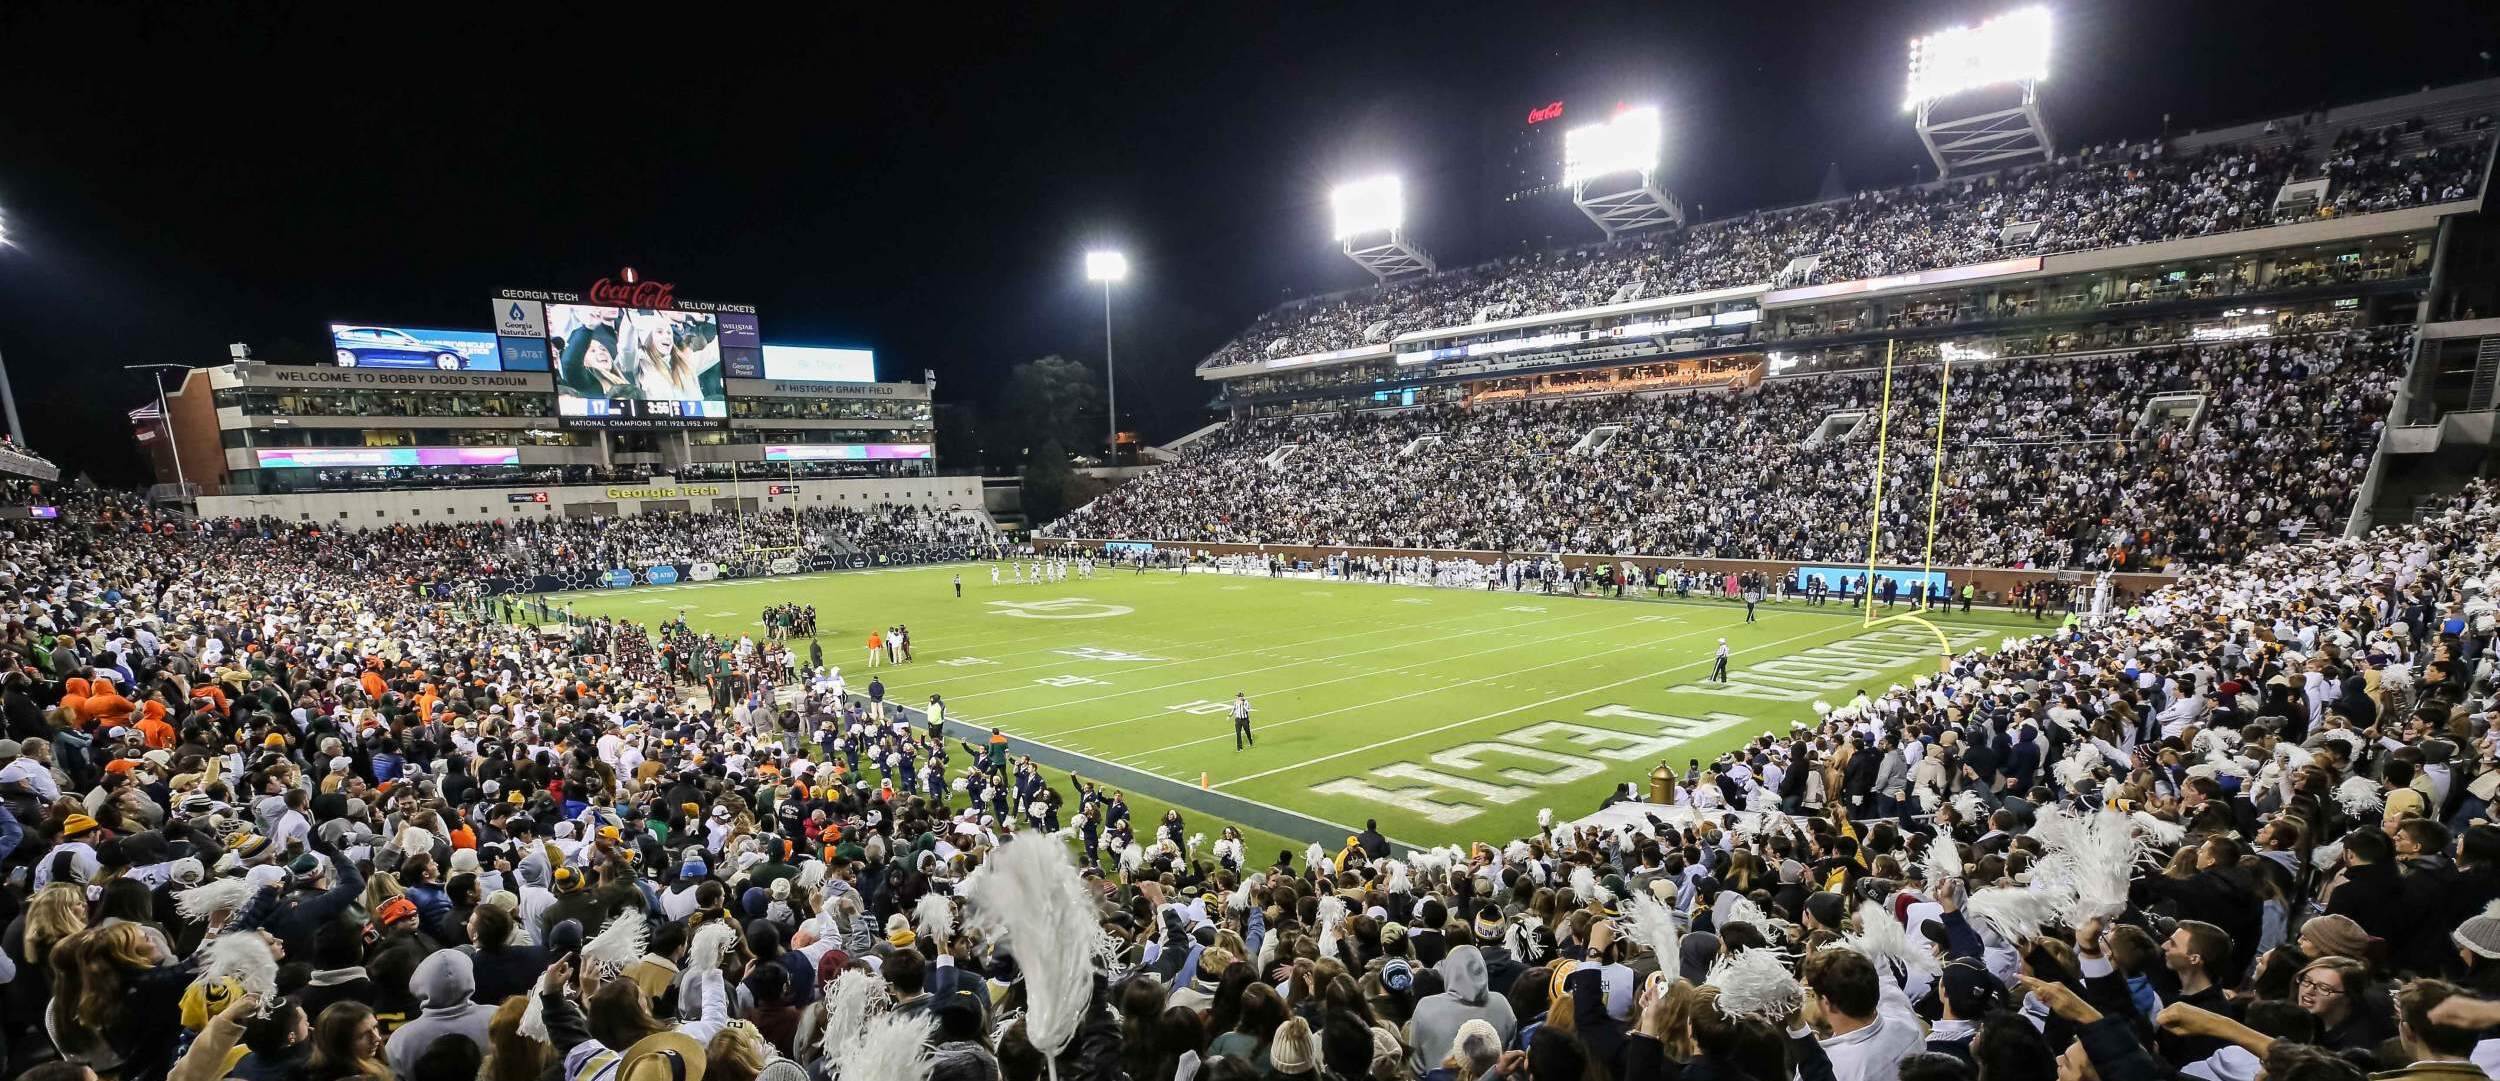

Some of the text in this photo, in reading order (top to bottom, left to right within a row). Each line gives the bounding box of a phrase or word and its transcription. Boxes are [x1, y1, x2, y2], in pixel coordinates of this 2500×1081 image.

[502, 289, 579, 302] GEORGIA TECH
[678, 301, 756, 314] YELLOW JACKETS
[505, 322, 532, 330] Georgia
[520, 350, 545, 359] AT&T
[276, 371, 528, 386] WELCOME TO BOBBY DODD STADIUM
[775, 384, 893, 395] AT HISTORIC GRANT FIELD
[592, 400, 607, 414] 17
[607, 485, 720, 499] Georgia Tech
[774, 562, 797, 572] sage
[1309, 703, 1752, 825] TECH
